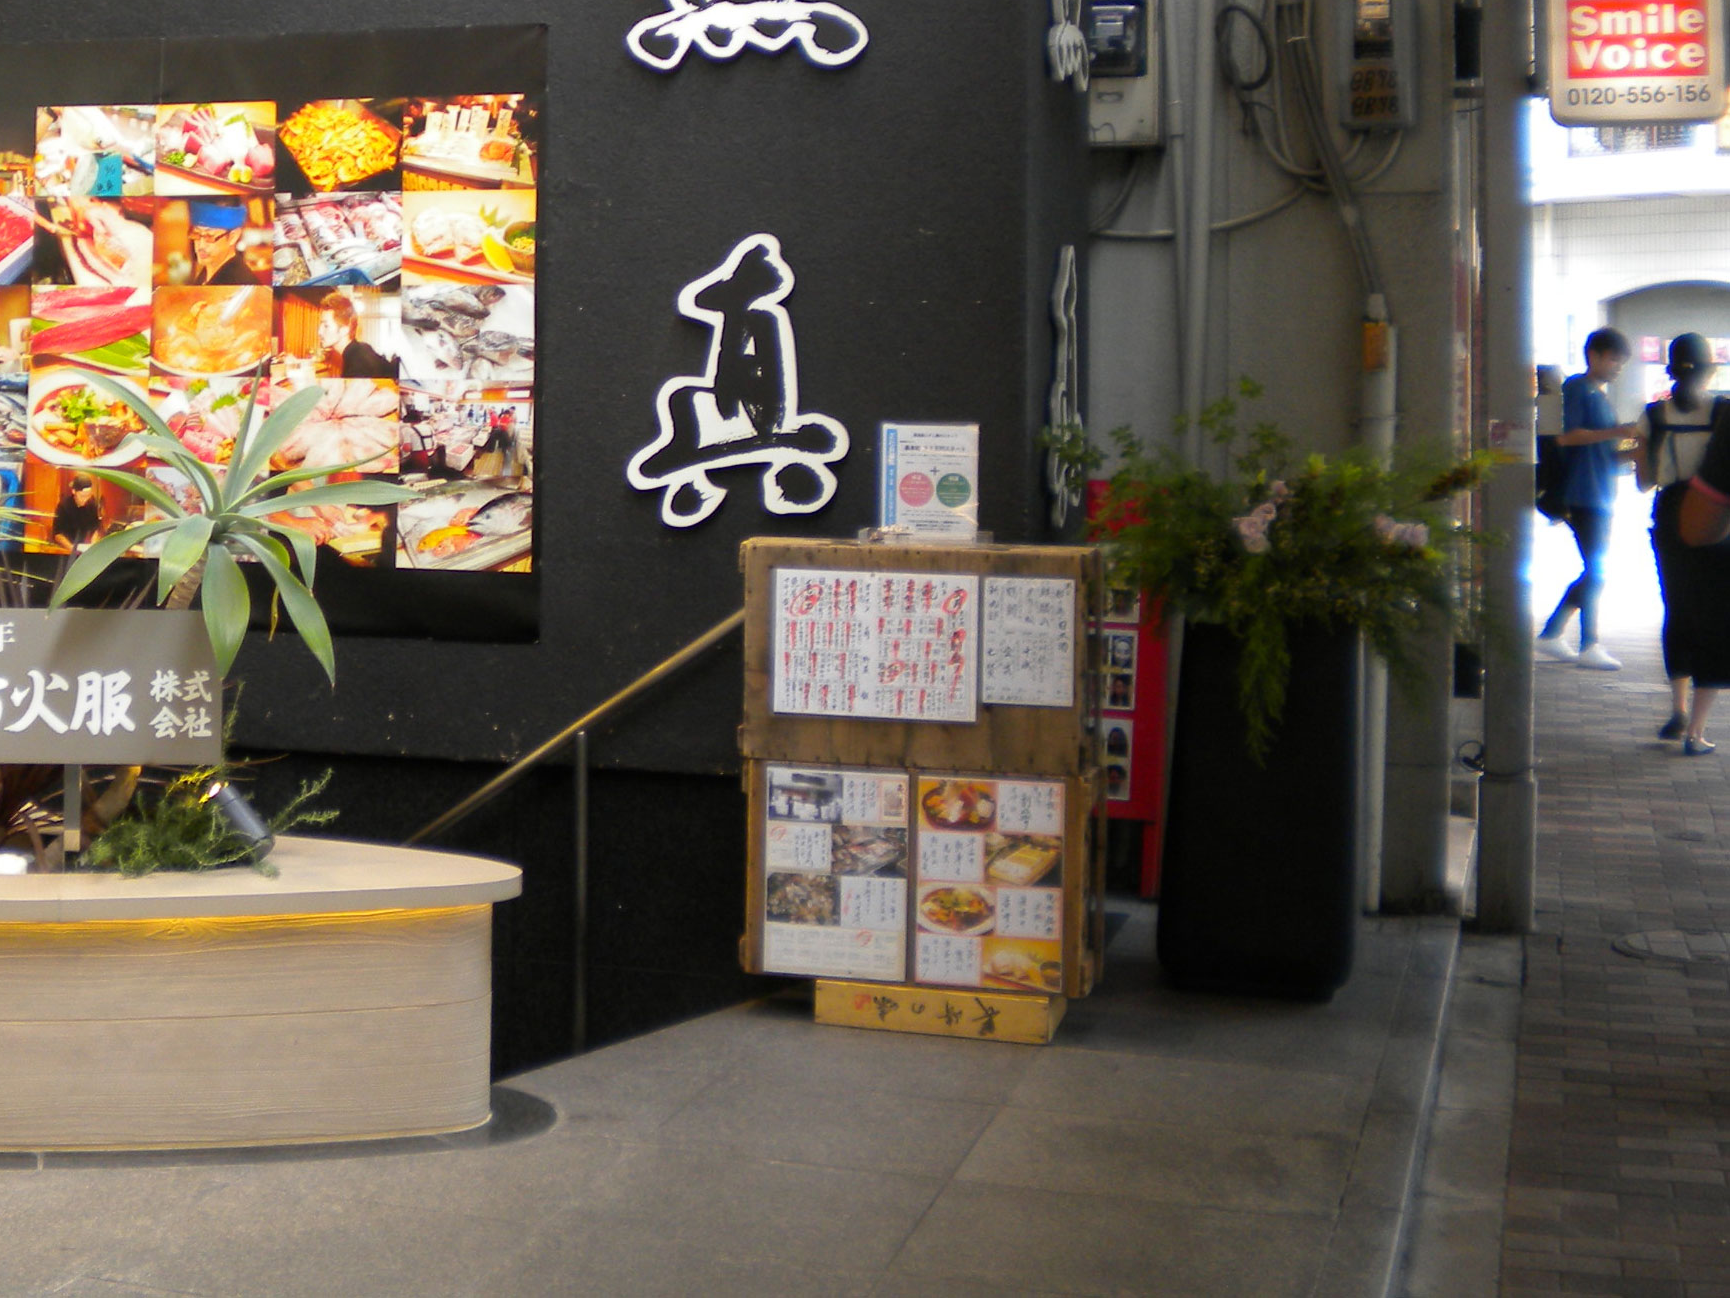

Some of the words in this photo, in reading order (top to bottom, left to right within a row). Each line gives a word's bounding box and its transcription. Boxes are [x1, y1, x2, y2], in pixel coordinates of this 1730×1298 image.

[1570, 4, 1705, 38] Smile
[1570, 40, 1707, 72] Voice
[1567, 83, 1711, 106] 0120-556-156
[150, 669, 213, 703] 株式
[149, 705, 213, 739] 会社
